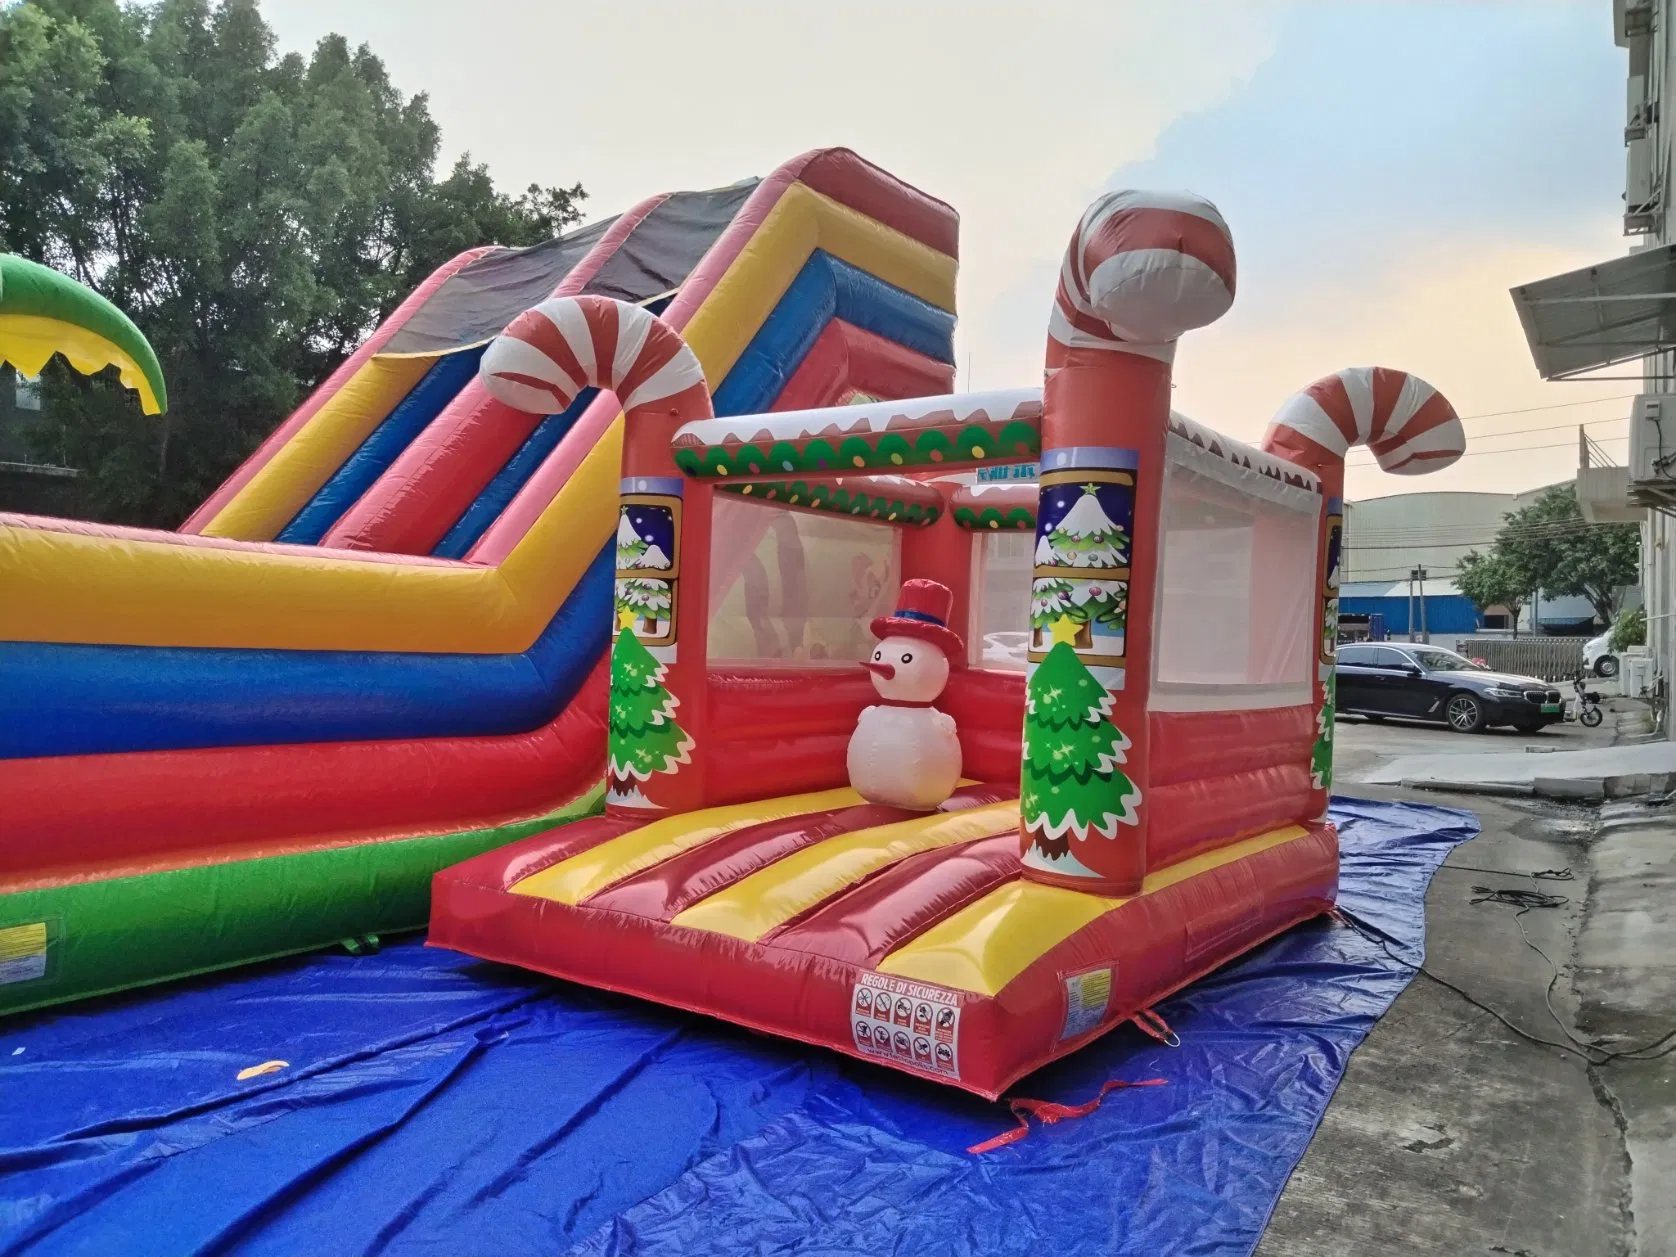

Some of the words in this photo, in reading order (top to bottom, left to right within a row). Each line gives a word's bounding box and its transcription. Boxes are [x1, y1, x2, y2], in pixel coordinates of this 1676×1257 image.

[861, 973, 895, 991] REGOLE
[895, 981, 907, 994] DI
[907, 984, 958, 1006] SICUREZZA
